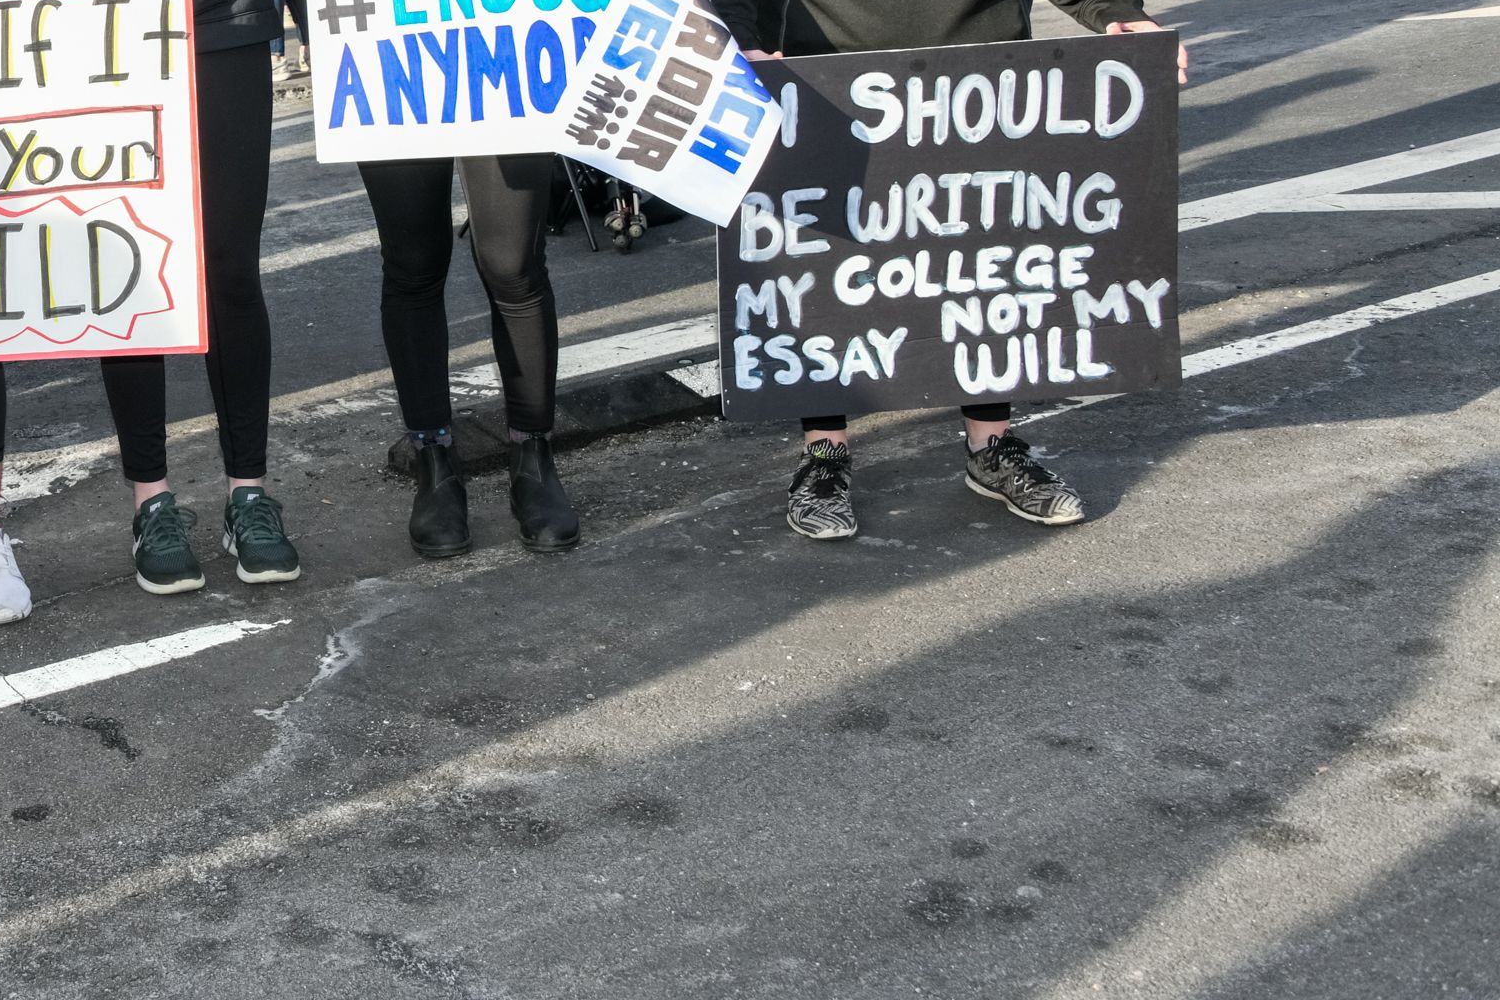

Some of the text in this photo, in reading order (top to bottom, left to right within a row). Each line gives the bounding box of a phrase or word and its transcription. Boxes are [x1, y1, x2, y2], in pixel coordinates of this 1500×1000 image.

[329, 15, 596, 130] ANYMO
[616, 56, 712, 172] OUR
[780, 59, 1144, 148] I SHOULD
[739, 170, 1123, 262] BE WRITING
[734, 244, 1094, 330] MY COLLEGE
[940, 277, 1171, 343] NOT MY
[732, 326, 1115, 395] ESSAY WILL
